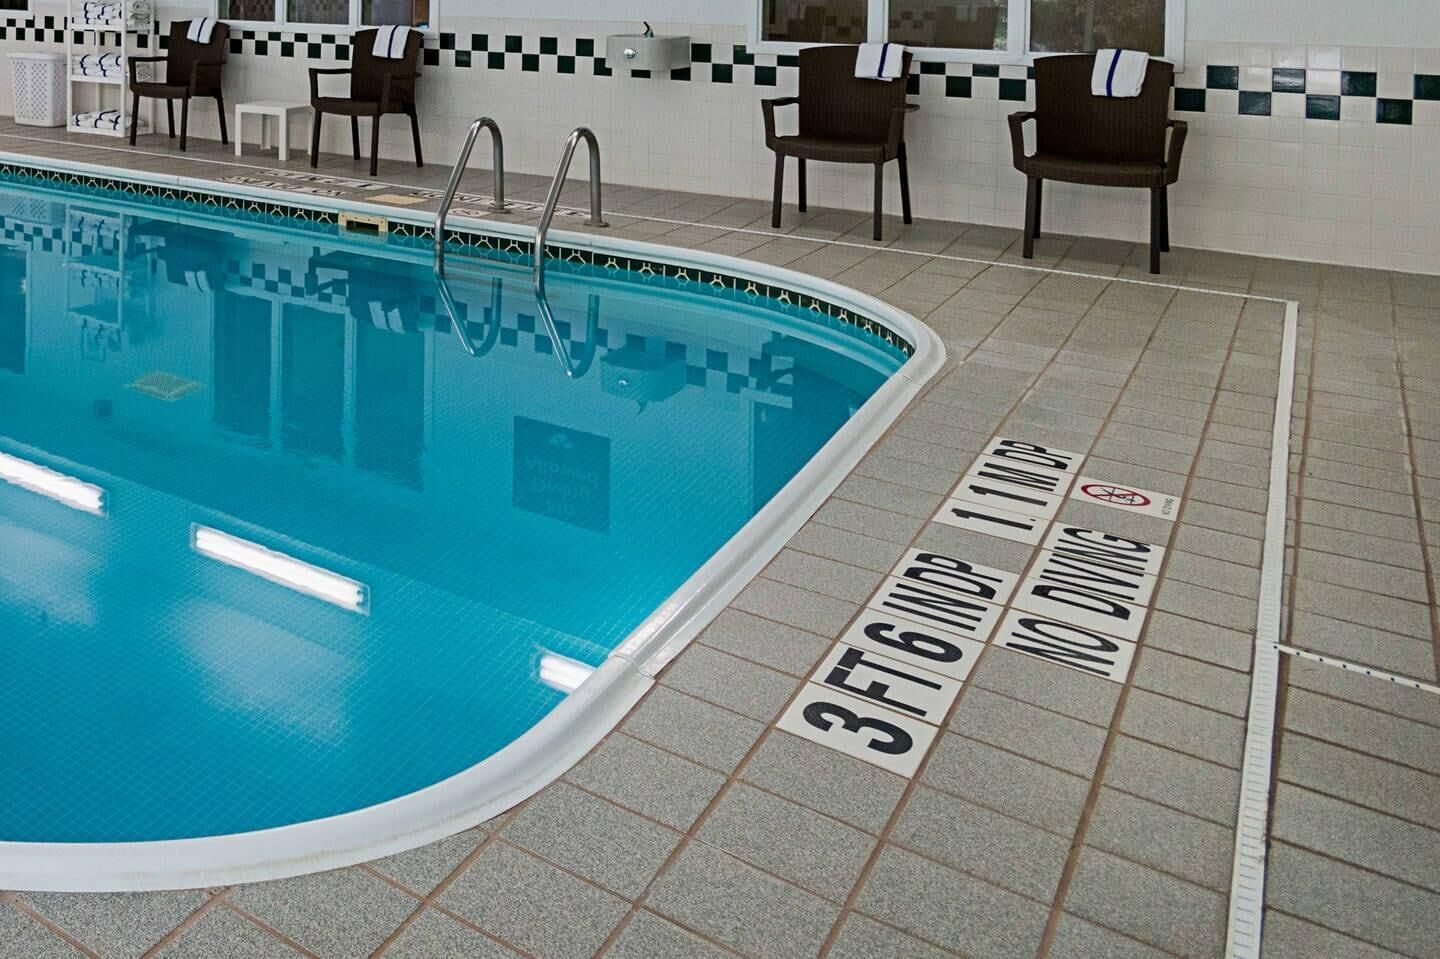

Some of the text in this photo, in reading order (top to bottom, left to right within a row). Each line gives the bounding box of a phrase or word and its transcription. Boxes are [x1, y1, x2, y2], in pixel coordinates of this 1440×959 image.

[1006, 527, 1151, 677] NO DIVING
[863, 622, 963, 663] 6
[824, 647, 942, 717] FT
[802, 701, 913, 756] 3
